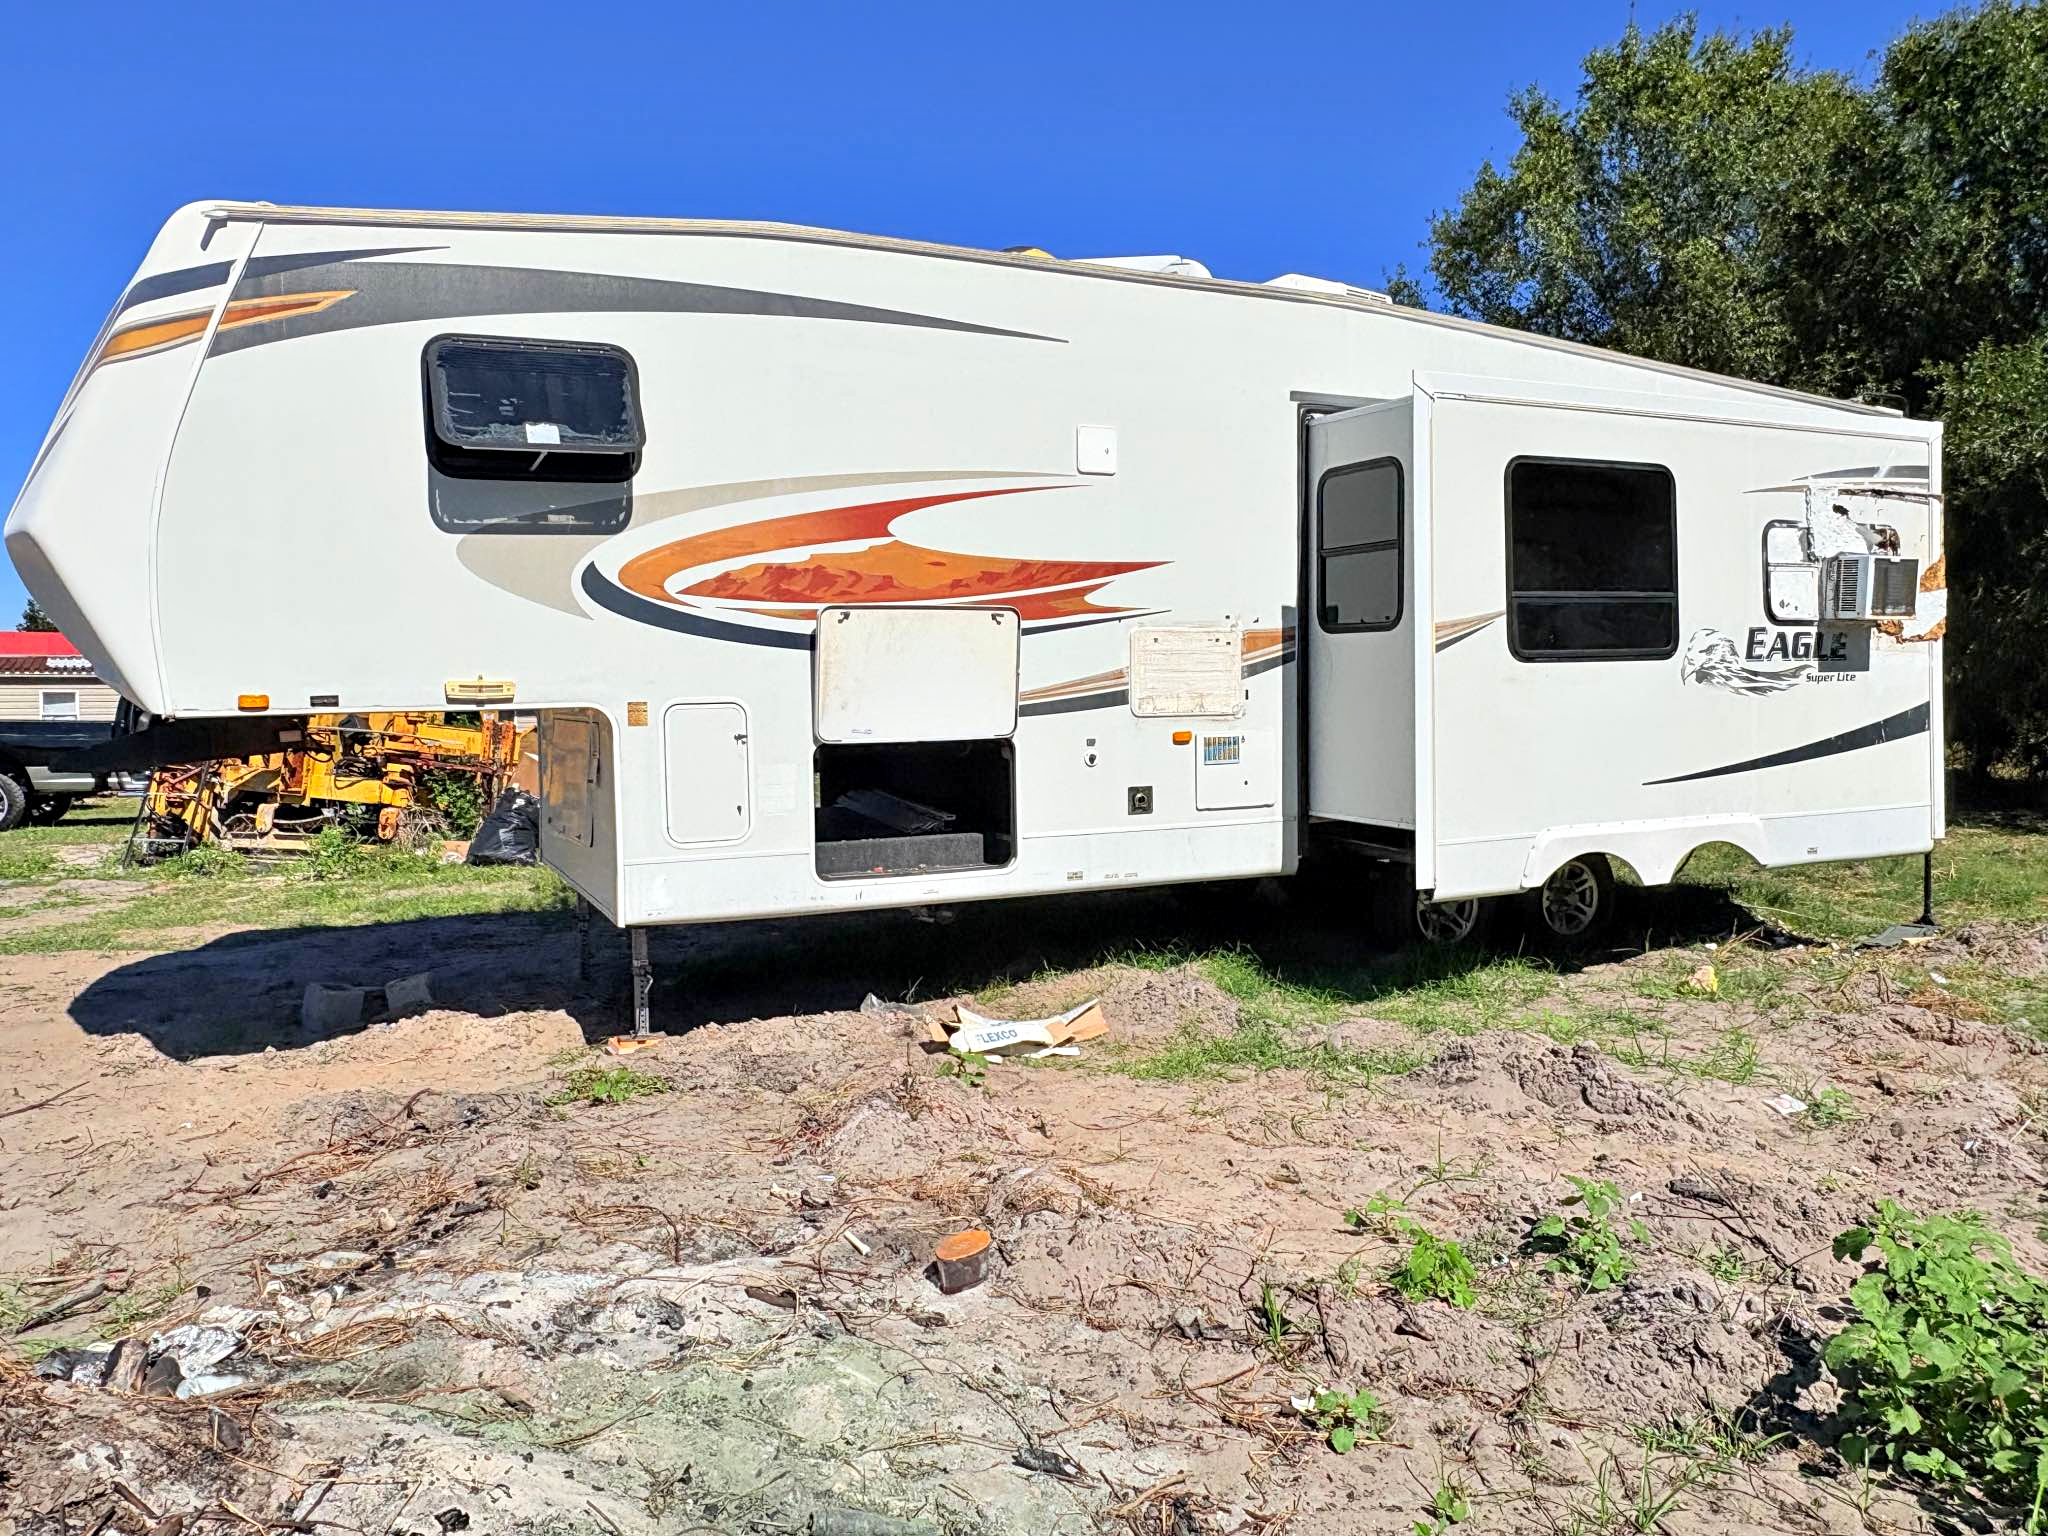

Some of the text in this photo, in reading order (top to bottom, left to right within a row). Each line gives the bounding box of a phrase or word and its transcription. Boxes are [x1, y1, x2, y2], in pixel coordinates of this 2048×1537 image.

[1745, 626, 1848, 661] EAGLE
[1806, 672, 1857, 684] Super Lite
